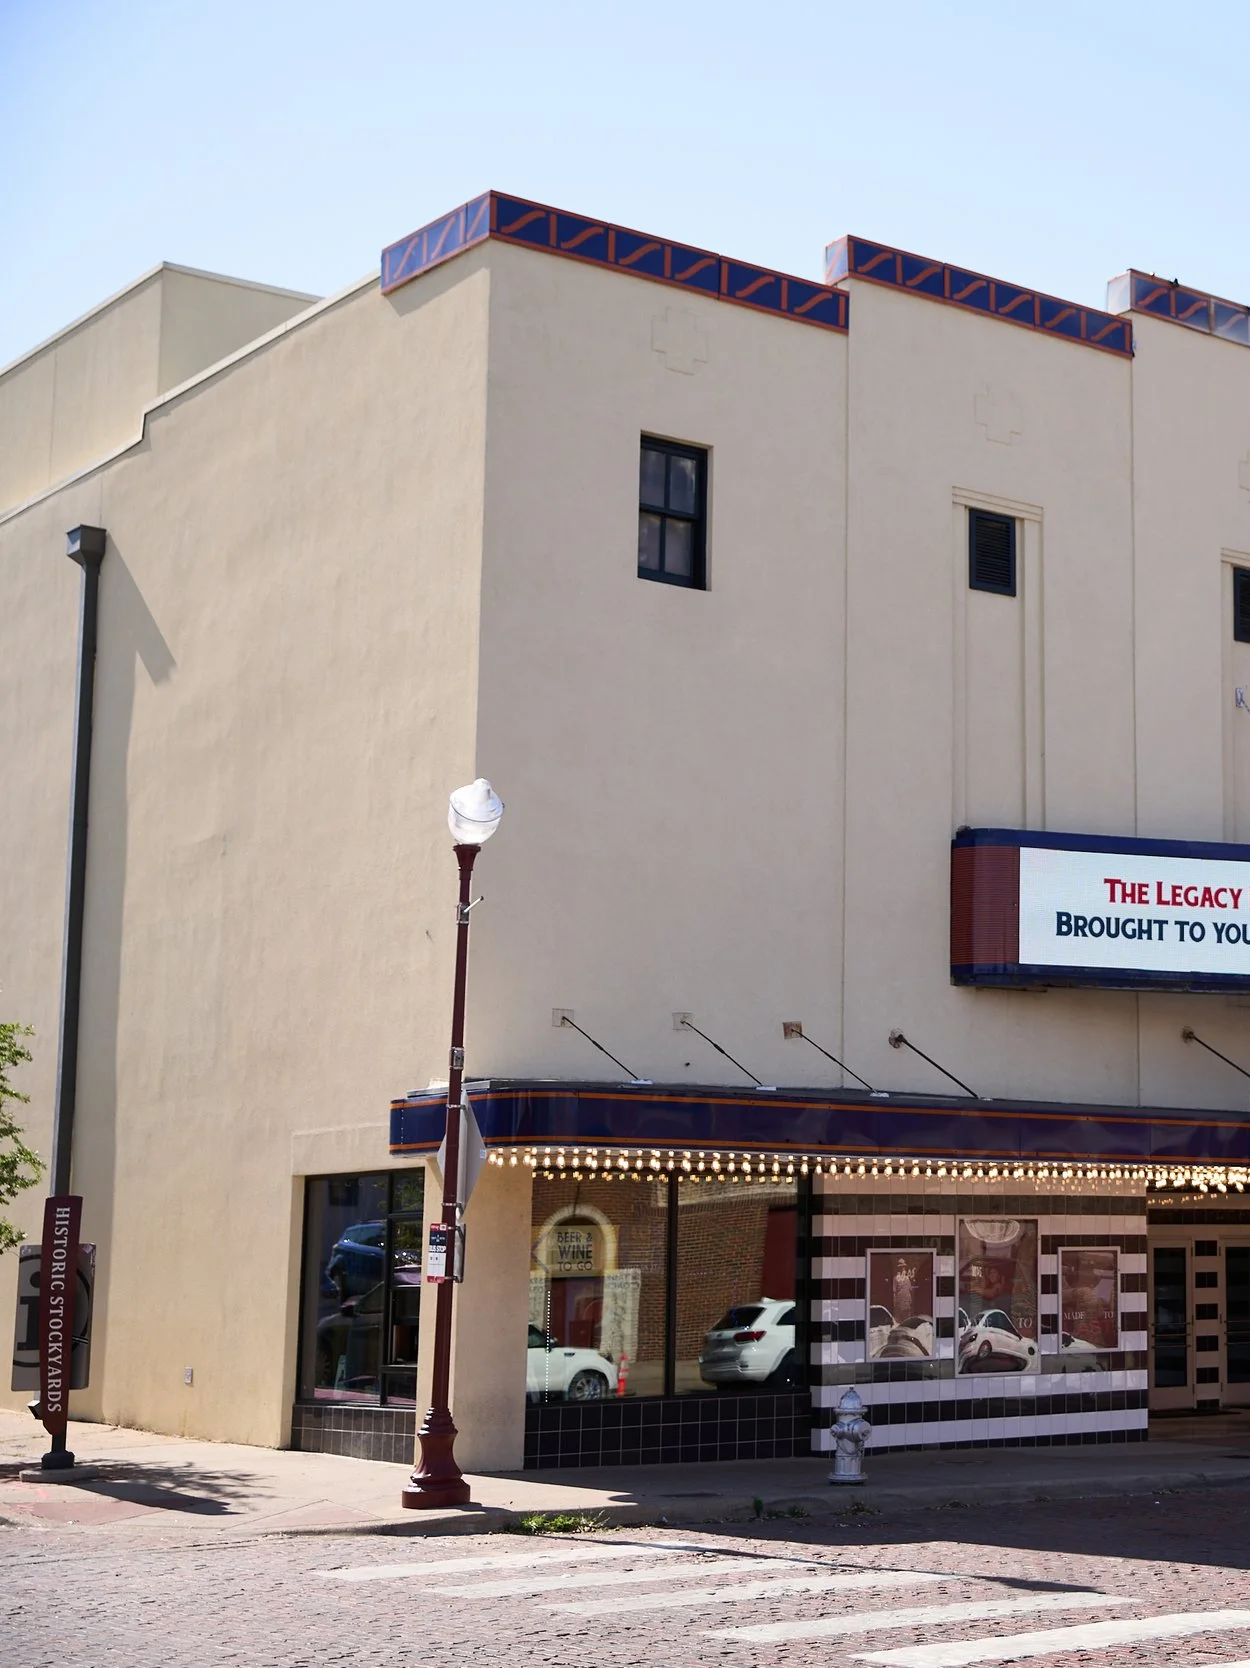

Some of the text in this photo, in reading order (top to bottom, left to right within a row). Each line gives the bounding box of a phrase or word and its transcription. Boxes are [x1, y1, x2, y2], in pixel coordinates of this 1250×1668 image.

[1104, 878, 1149, 904] THE
[1156, 881, 1243, 909] LEGACY
[1056, 911, 1169, 941] BROUGHT
[1174, 920, 1206, 943] TO
[557, 1232, 593, 1243] BEER &
[558, 1244, 593, 1259] WINE
[558, 1261, 593, 1272] TO GO
[47, 1206, 71, 1413] HISTORIC STOCKYARDS
[1064, 1311, 1114, 1320] MADE TO
[1017, 1317, 1033, 1329] TO
